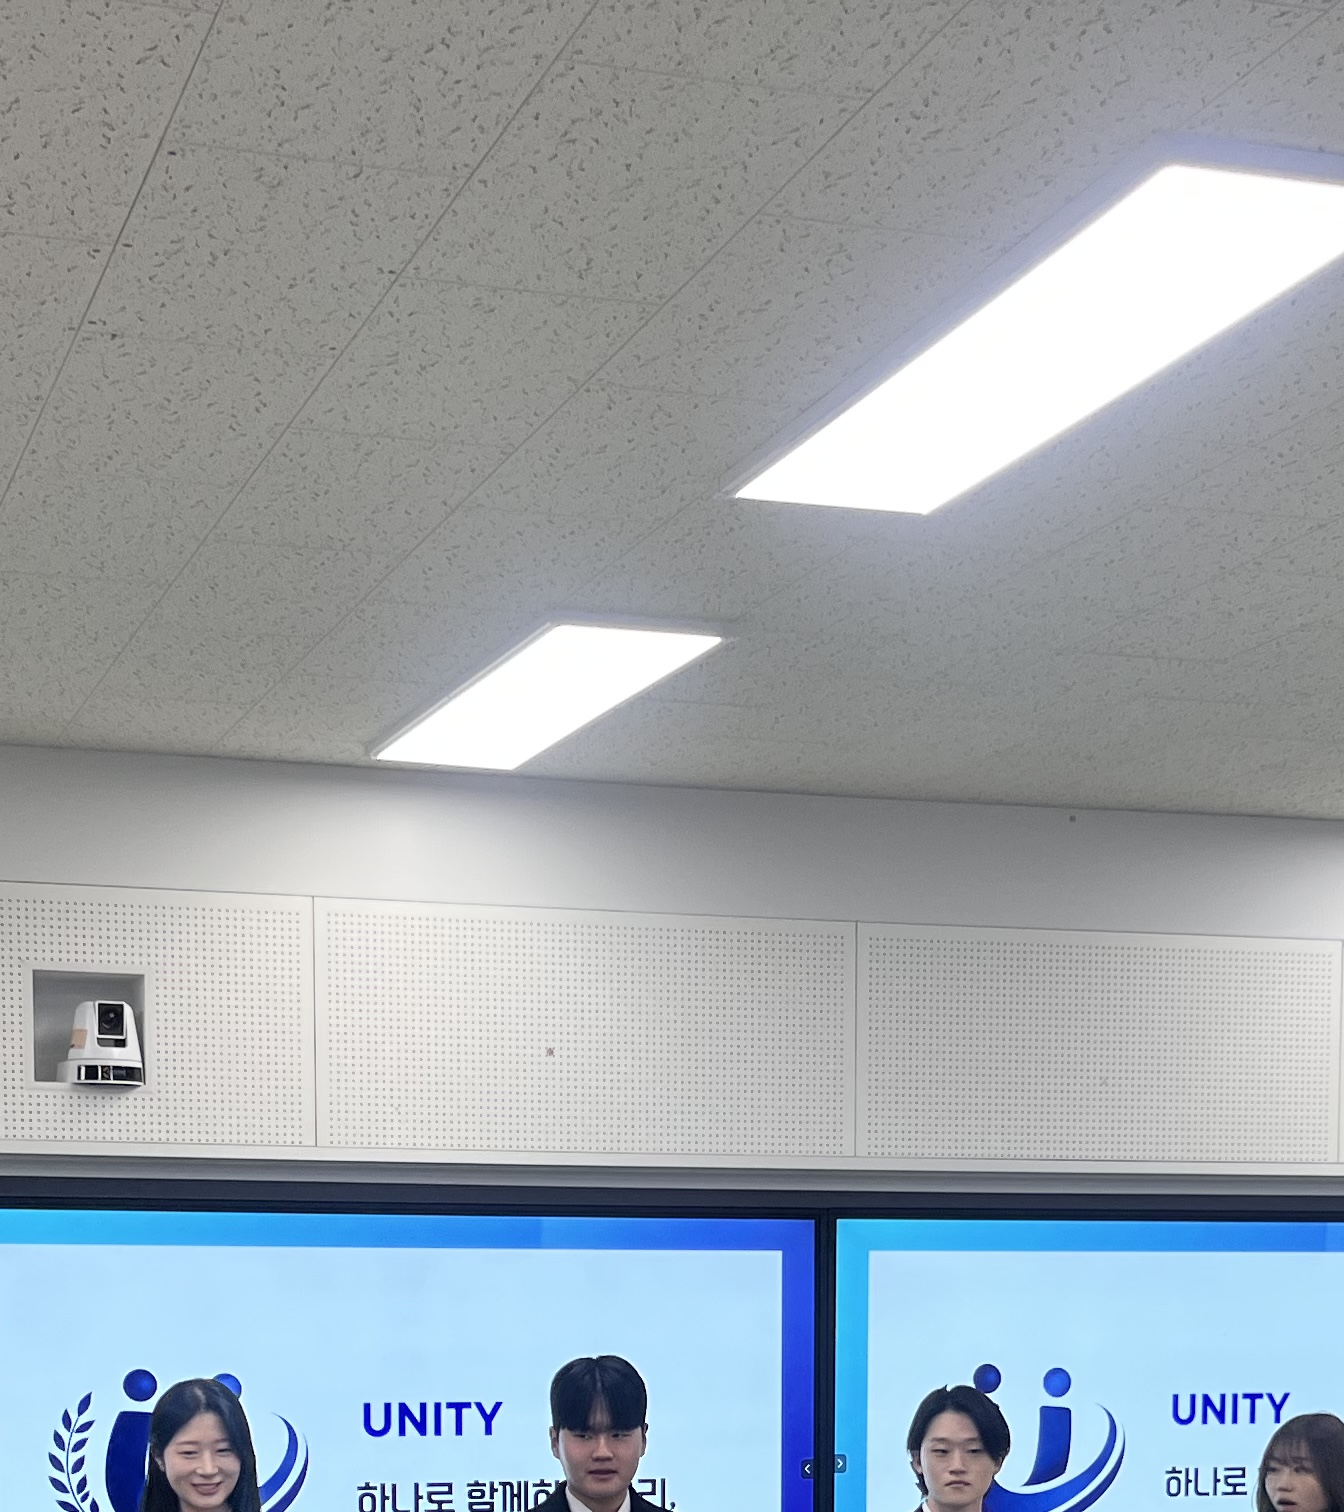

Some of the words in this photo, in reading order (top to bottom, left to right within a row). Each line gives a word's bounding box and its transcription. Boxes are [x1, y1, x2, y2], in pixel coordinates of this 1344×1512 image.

[363, 1401, 503, 1438] UNITY
[1172, 1392, 1291, 1426] UNITY
[1165, 1465, 1249, 1498] 하나로
